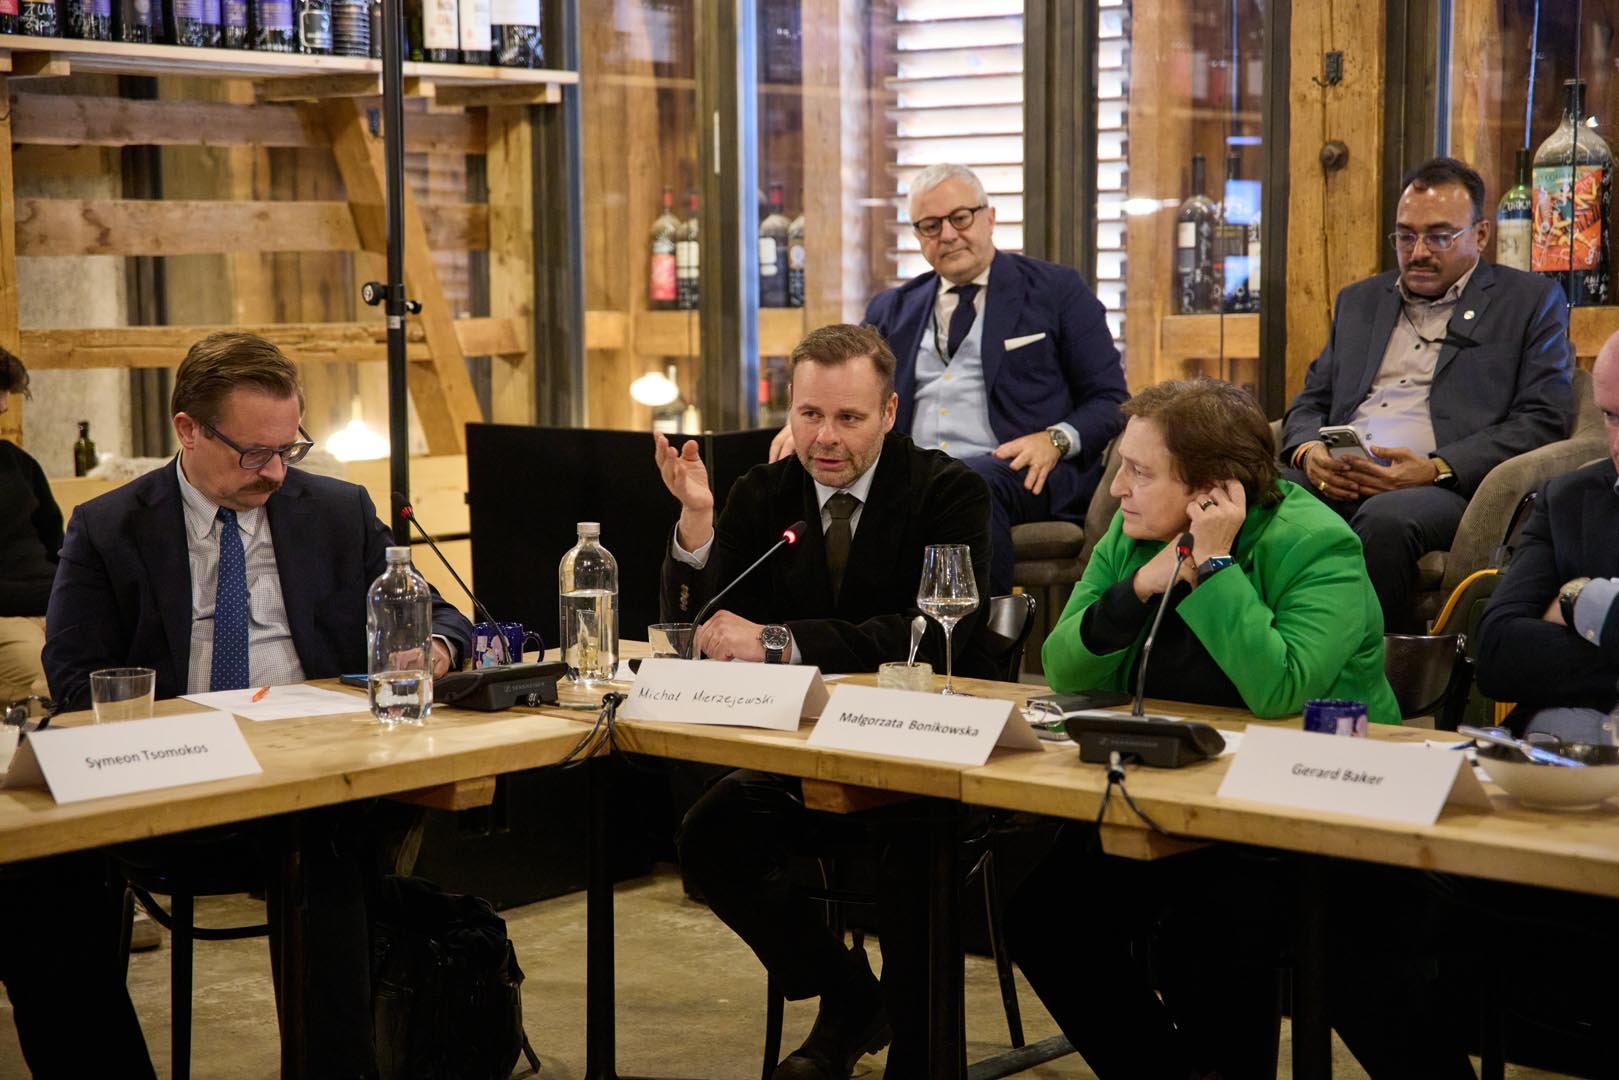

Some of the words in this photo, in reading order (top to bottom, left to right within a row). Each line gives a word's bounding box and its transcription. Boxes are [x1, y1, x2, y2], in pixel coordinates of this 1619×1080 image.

[908, 719, 979, 737] Bonikowska
[85, 753, 141, 770] Symeon
[141, 744, 208, 761] Tsomokos
[1291, 762, 1341, 780] Gerard
[1341, 769, 1384, 785] Baker
